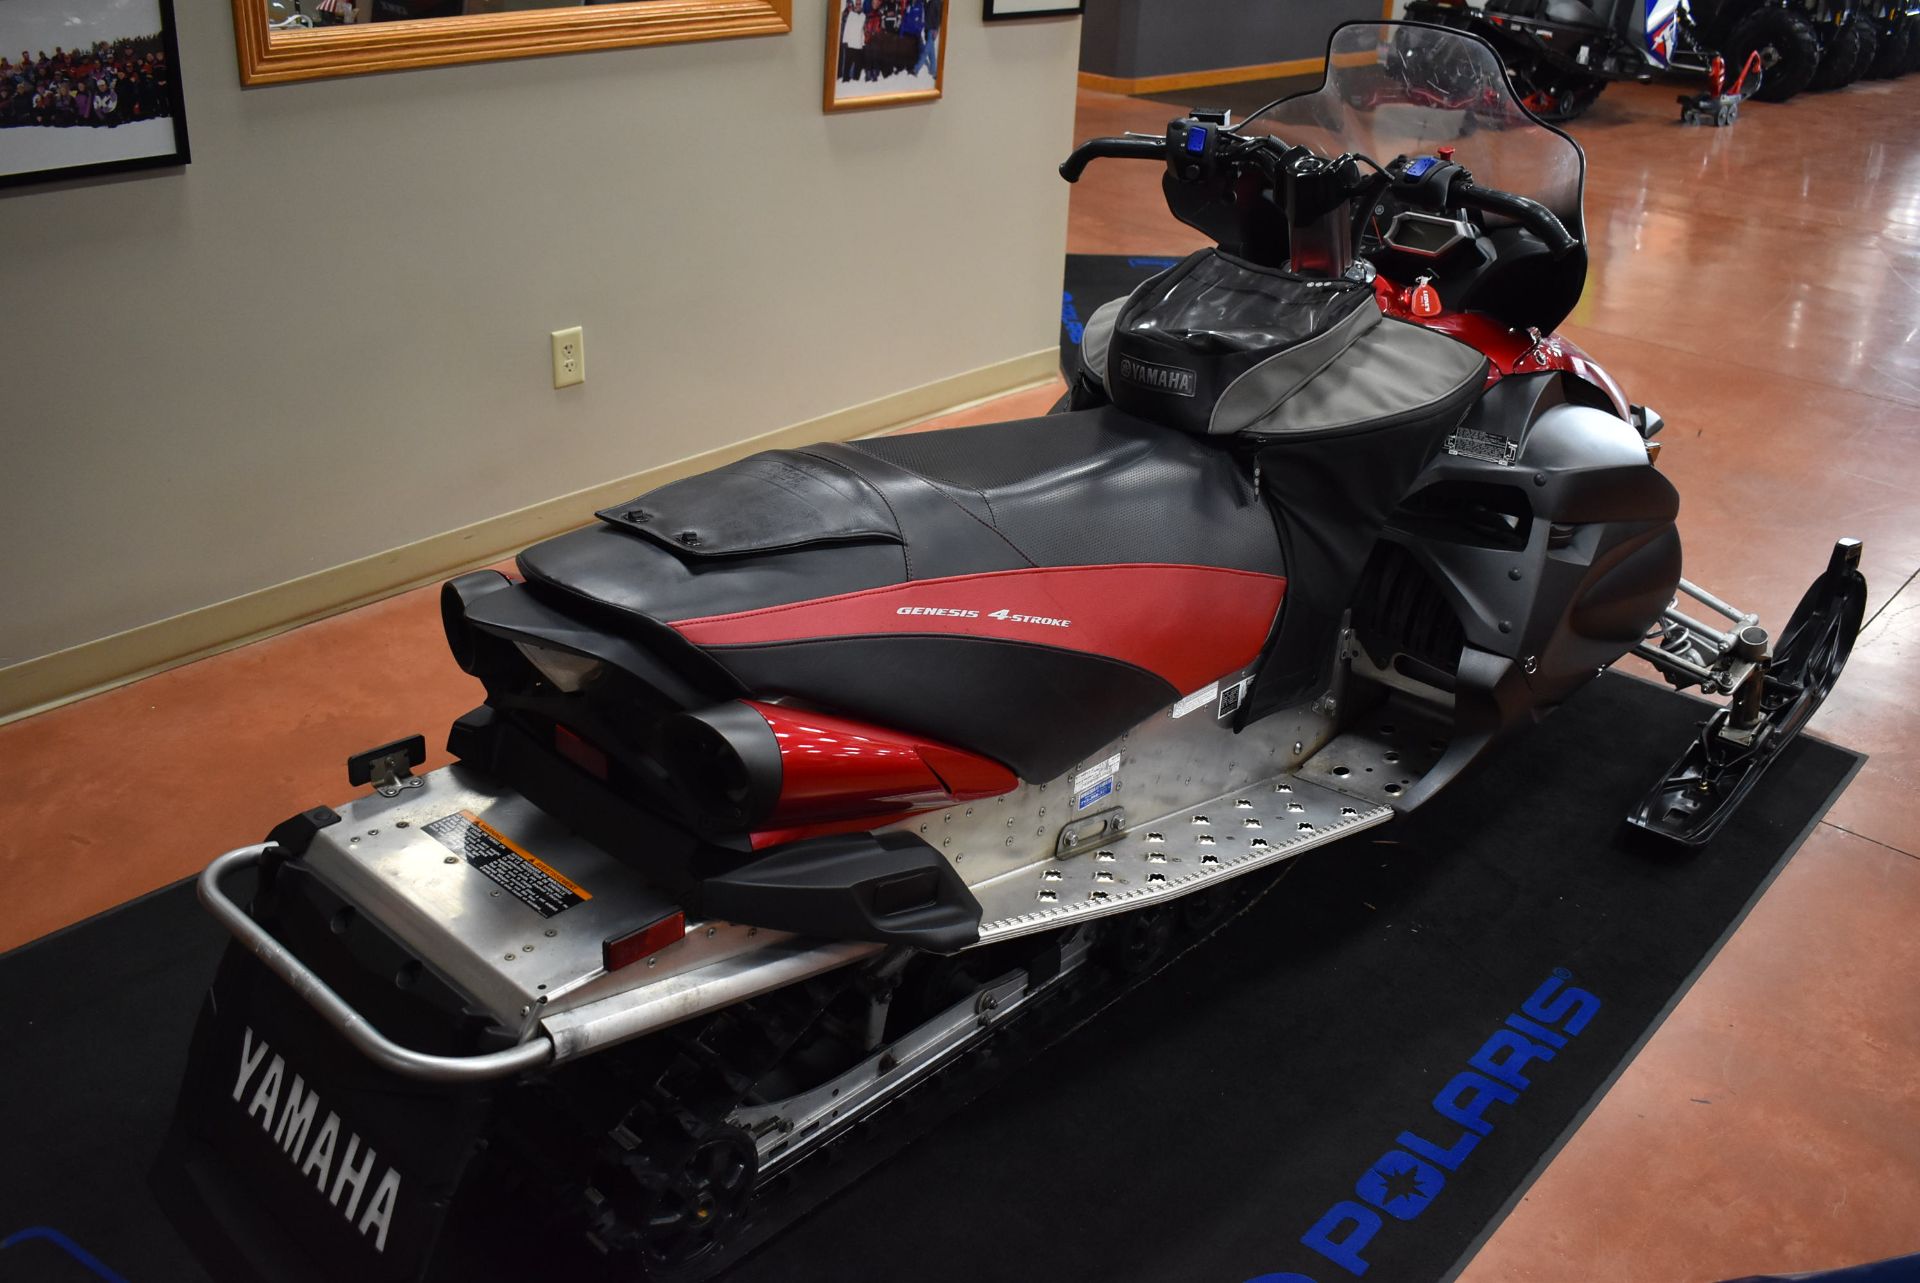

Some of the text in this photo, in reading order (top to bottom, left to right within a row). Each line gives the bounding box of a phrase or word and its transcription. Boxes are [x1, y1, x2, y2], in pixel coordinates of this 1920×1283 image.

[1132, 363, 1188, 390] YAMAHA
[896, 606, 980, 618] GENESIS
[232, 1025, 401, 1253] YAMAHA
